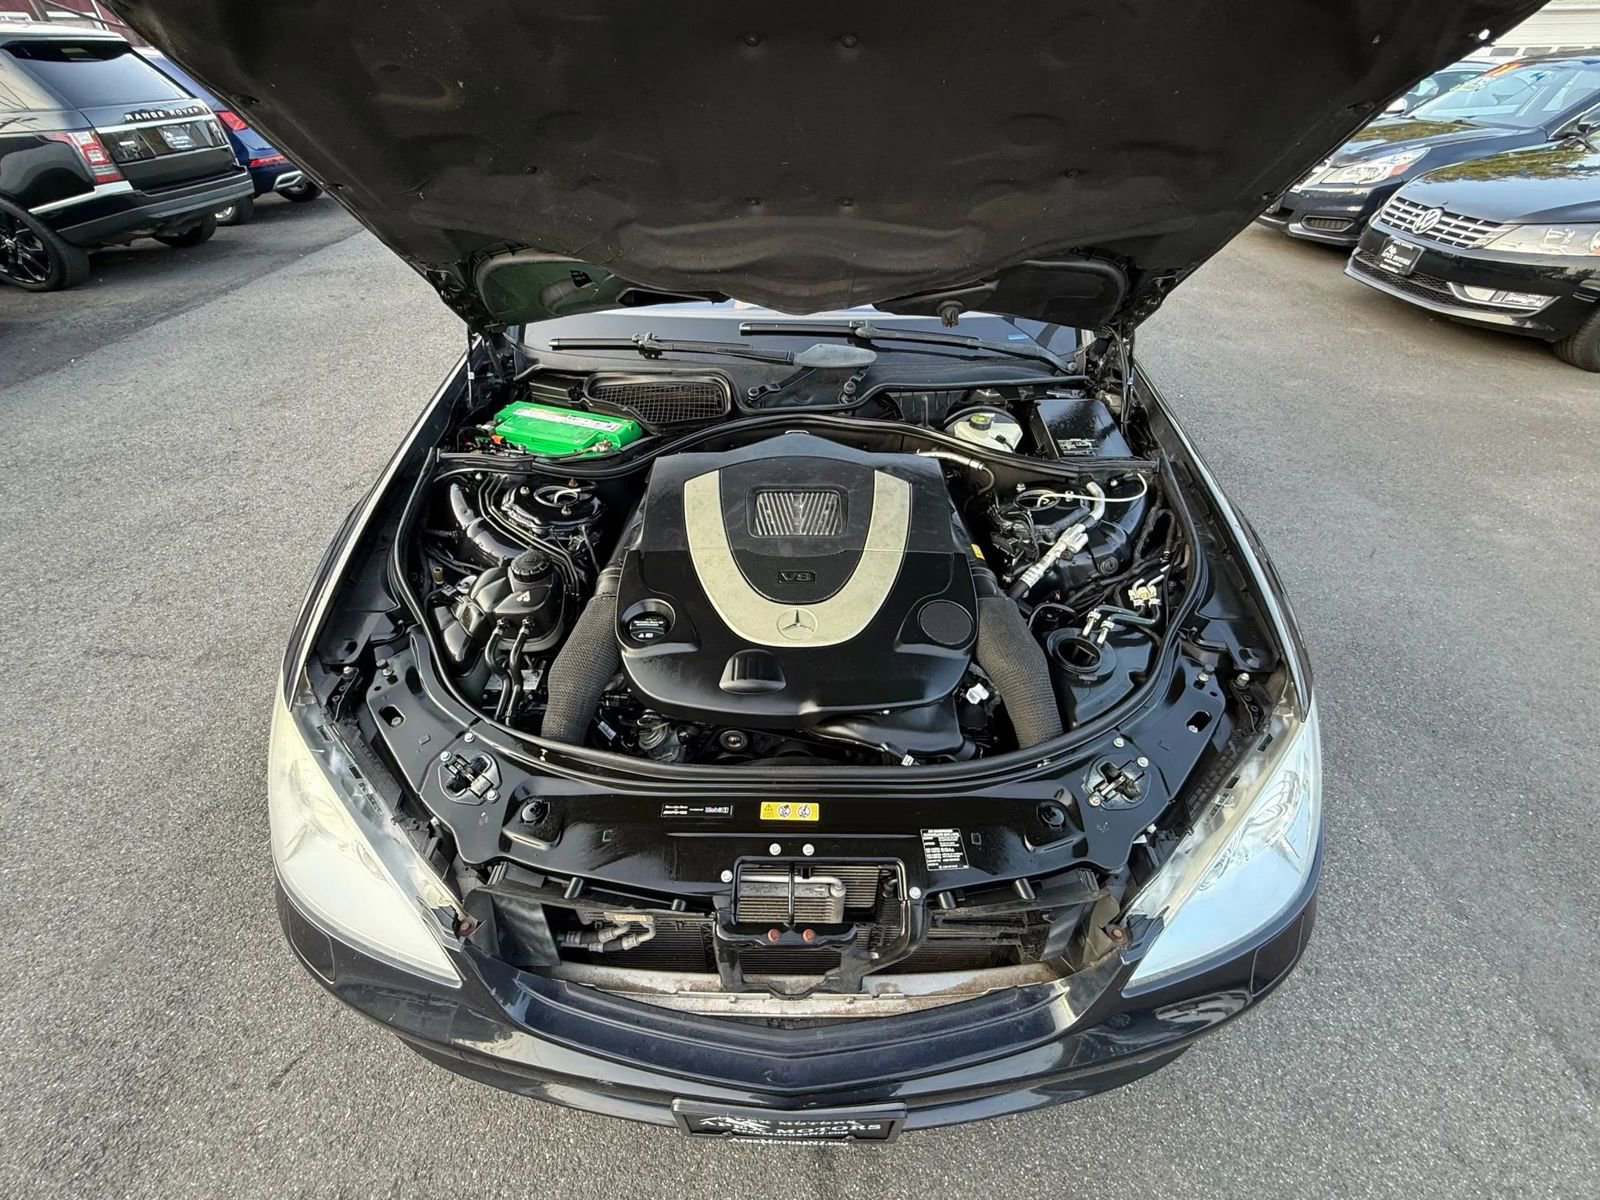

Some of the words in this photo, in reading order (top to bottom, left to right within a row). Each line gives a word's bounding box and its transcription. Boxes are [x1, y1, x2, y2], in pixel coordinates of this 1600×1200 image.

[124, 110, 165, 121] RANGE
[168, 107, 199, 117] ROVER
[781, 572, 811, 581] V8
[776, 1124, 881, 1134] MOTORS
